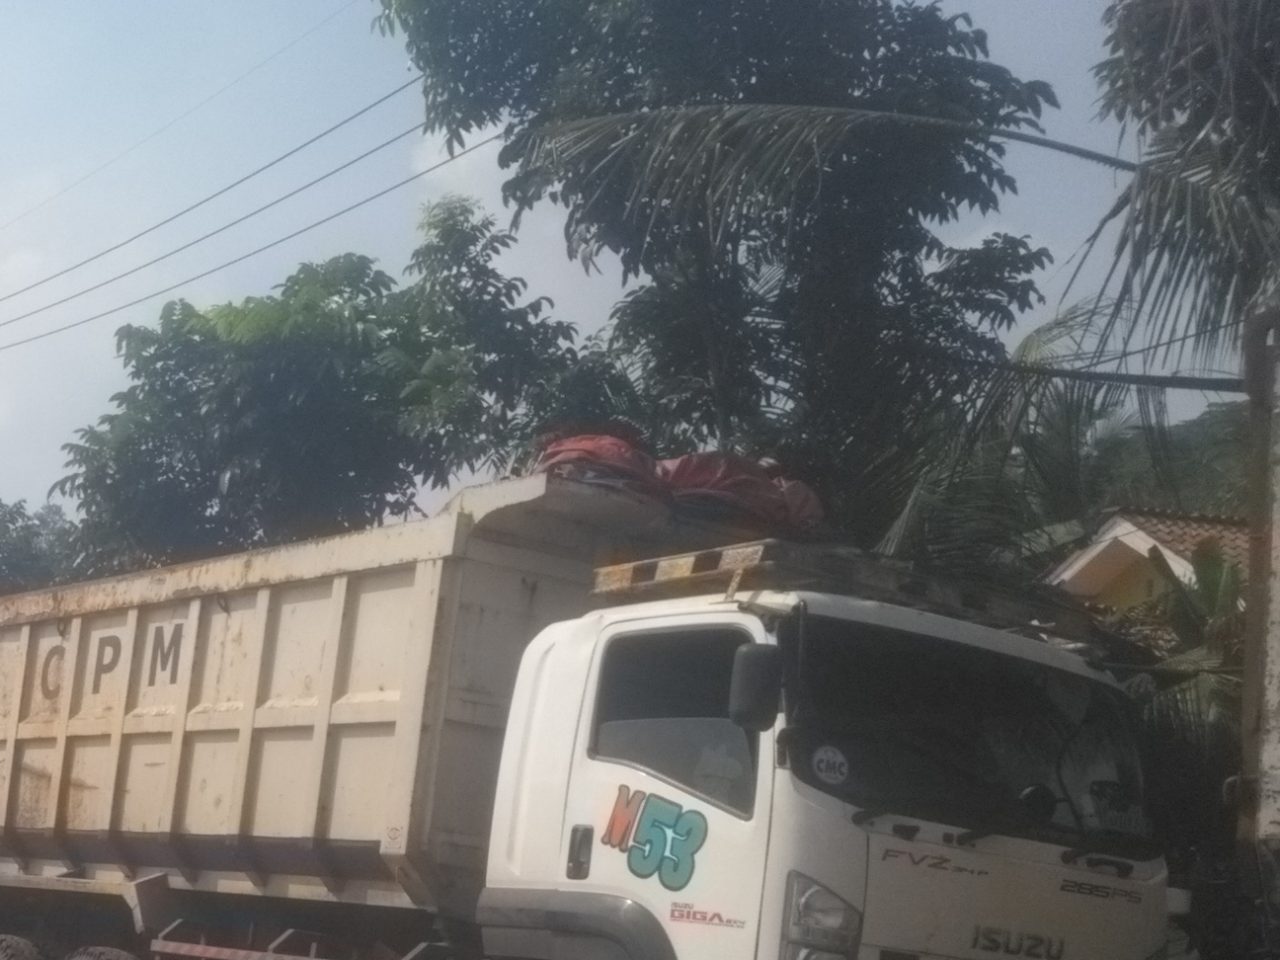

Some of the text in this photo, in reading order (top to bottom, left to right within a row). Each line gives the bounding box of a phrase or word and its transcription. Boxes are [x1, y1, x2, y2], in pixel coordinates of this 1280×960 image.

[41, 623, 184, 700] CPM
[601, 784, 708, 891] M53
[670, 909, 725, 924] GIGA
